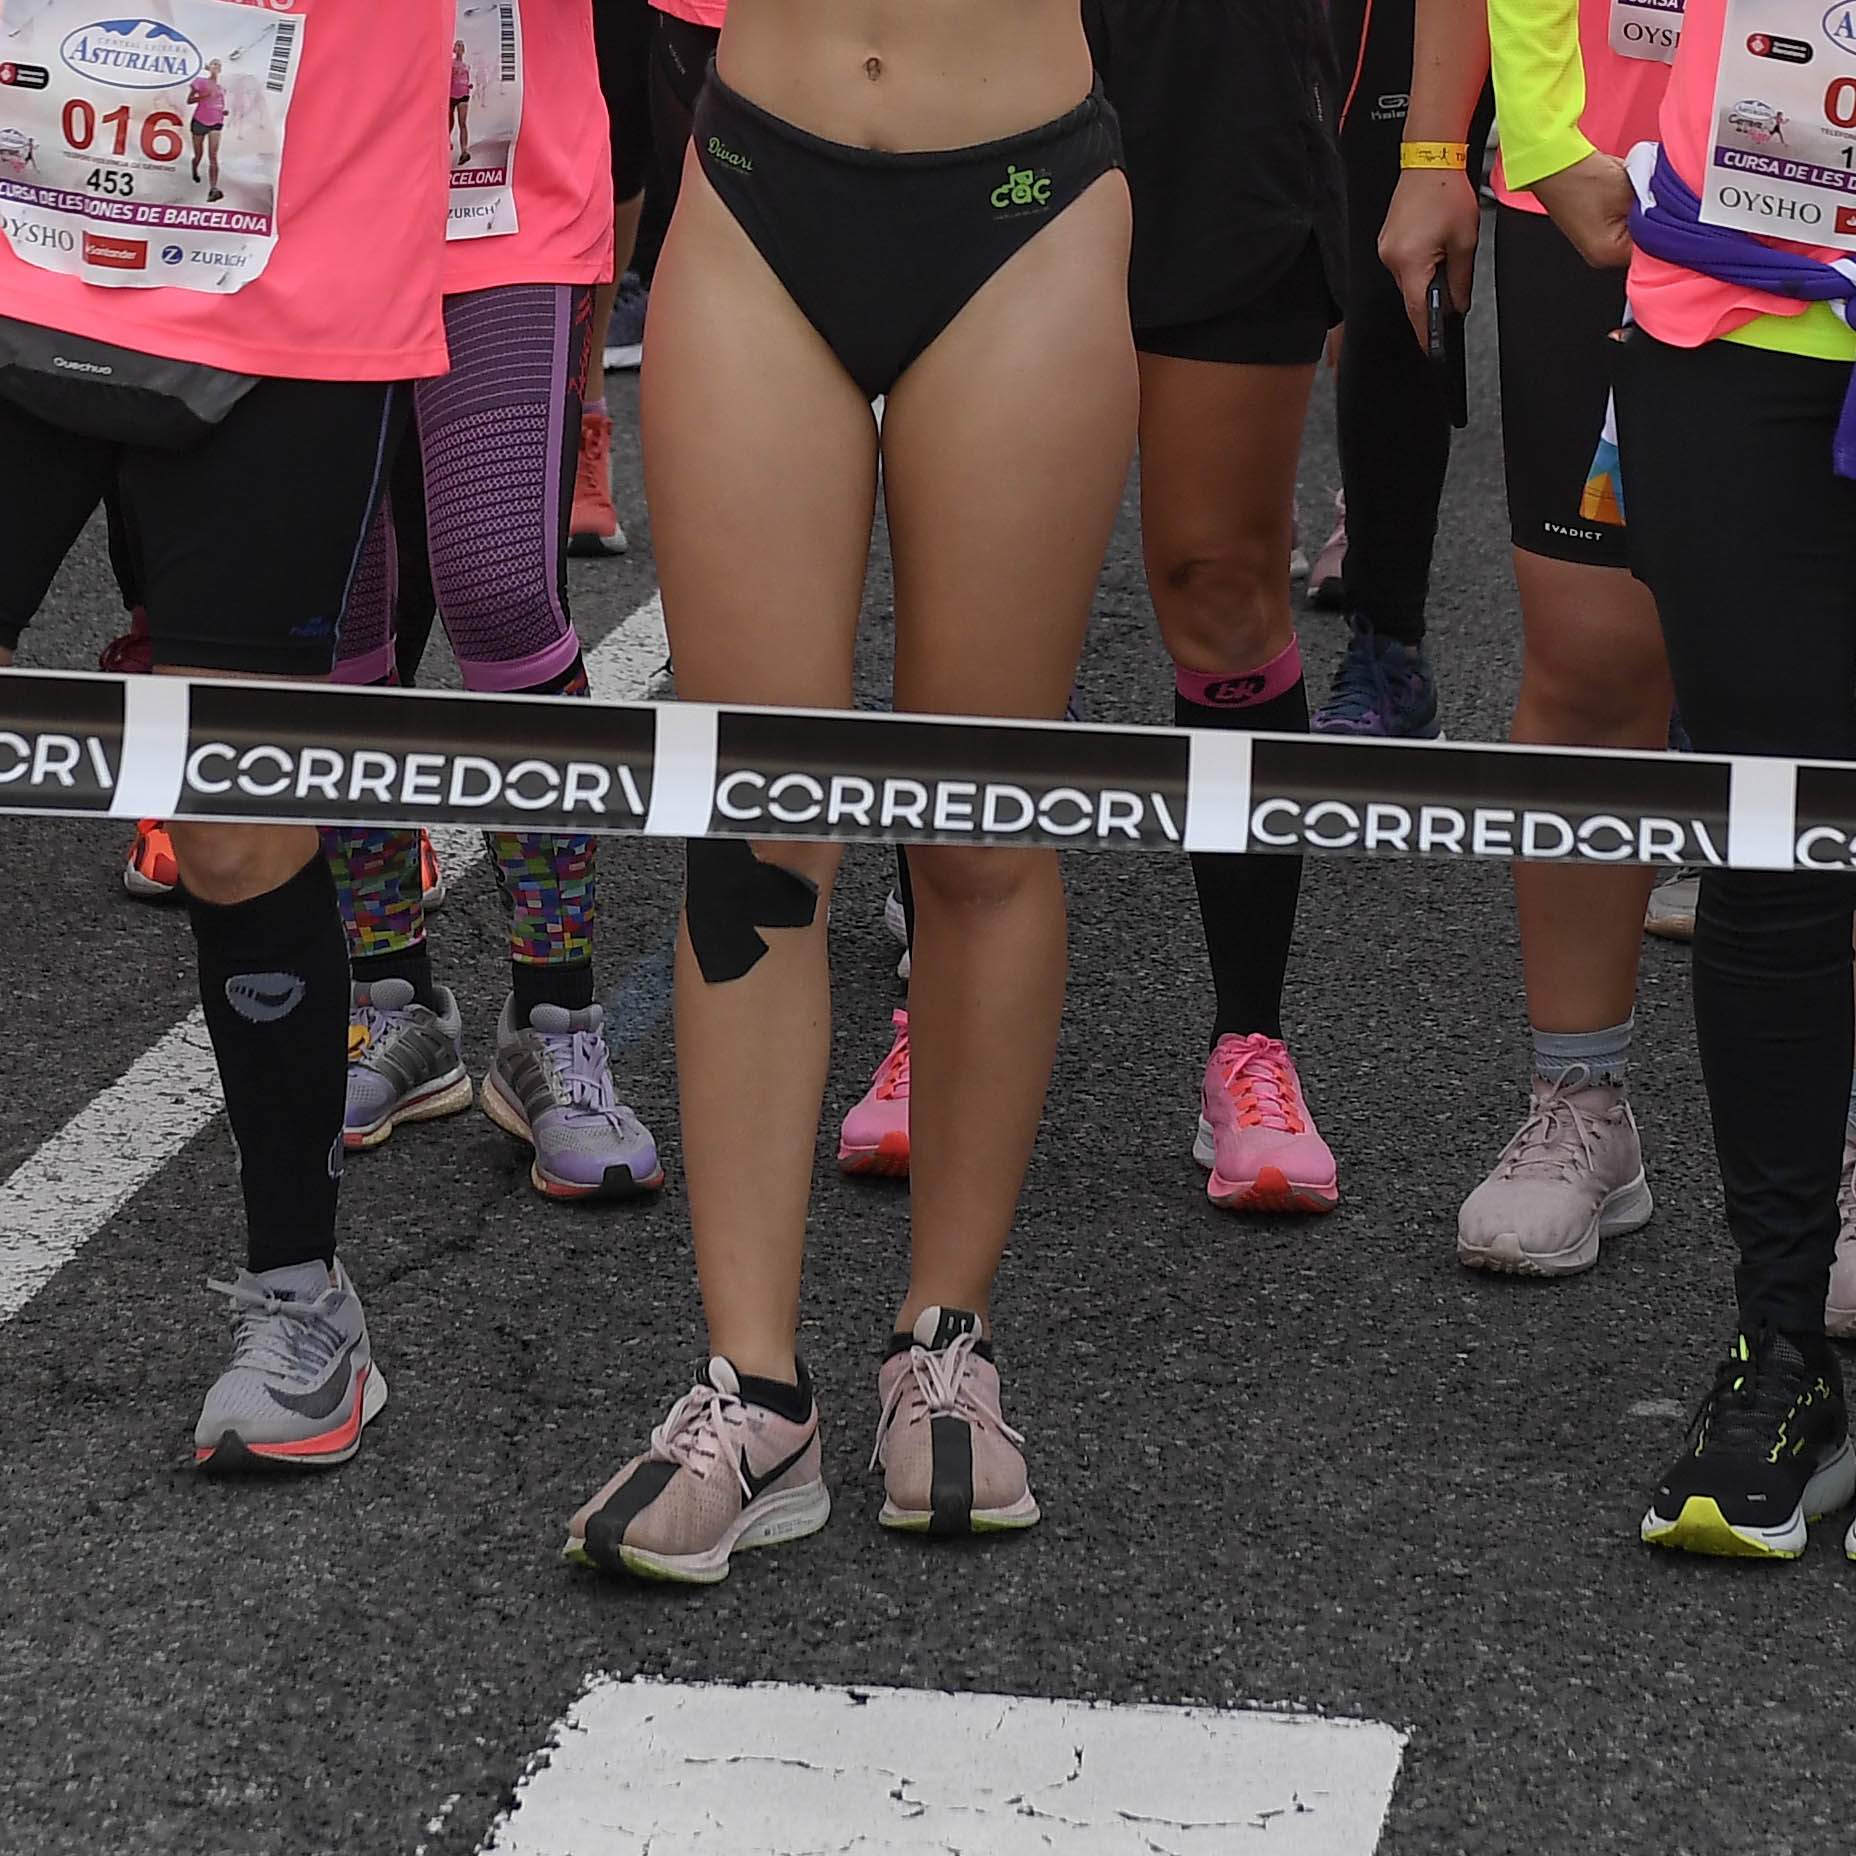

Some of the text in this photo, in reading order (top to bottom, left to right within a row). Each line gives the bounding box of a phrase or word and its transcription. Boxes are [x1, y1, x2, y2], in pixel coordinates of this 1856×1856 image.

[70, 35, 190, 76] ASTURIANA
[61, 98, 184, 162] 016
[86, 168, 134, 196] 453
[1723, 150, 1780, 176] CURSA
[1783, 162, 1807, 180] DE
[1810, 167, 1844, 187] LES
[38, 189, 59, 206] DE
[58, 193, 83, 210] LES
[136, 207, 160, 224] DE
[163, 208, 267, 232] BARCELONA
[1718, 185, 1822, 225] OYSHO
[190, 250, 246, 268] ZURICH
[53, 356, 112, 375] Quechua
[1544, 522, 1602, 541] EVADICT
